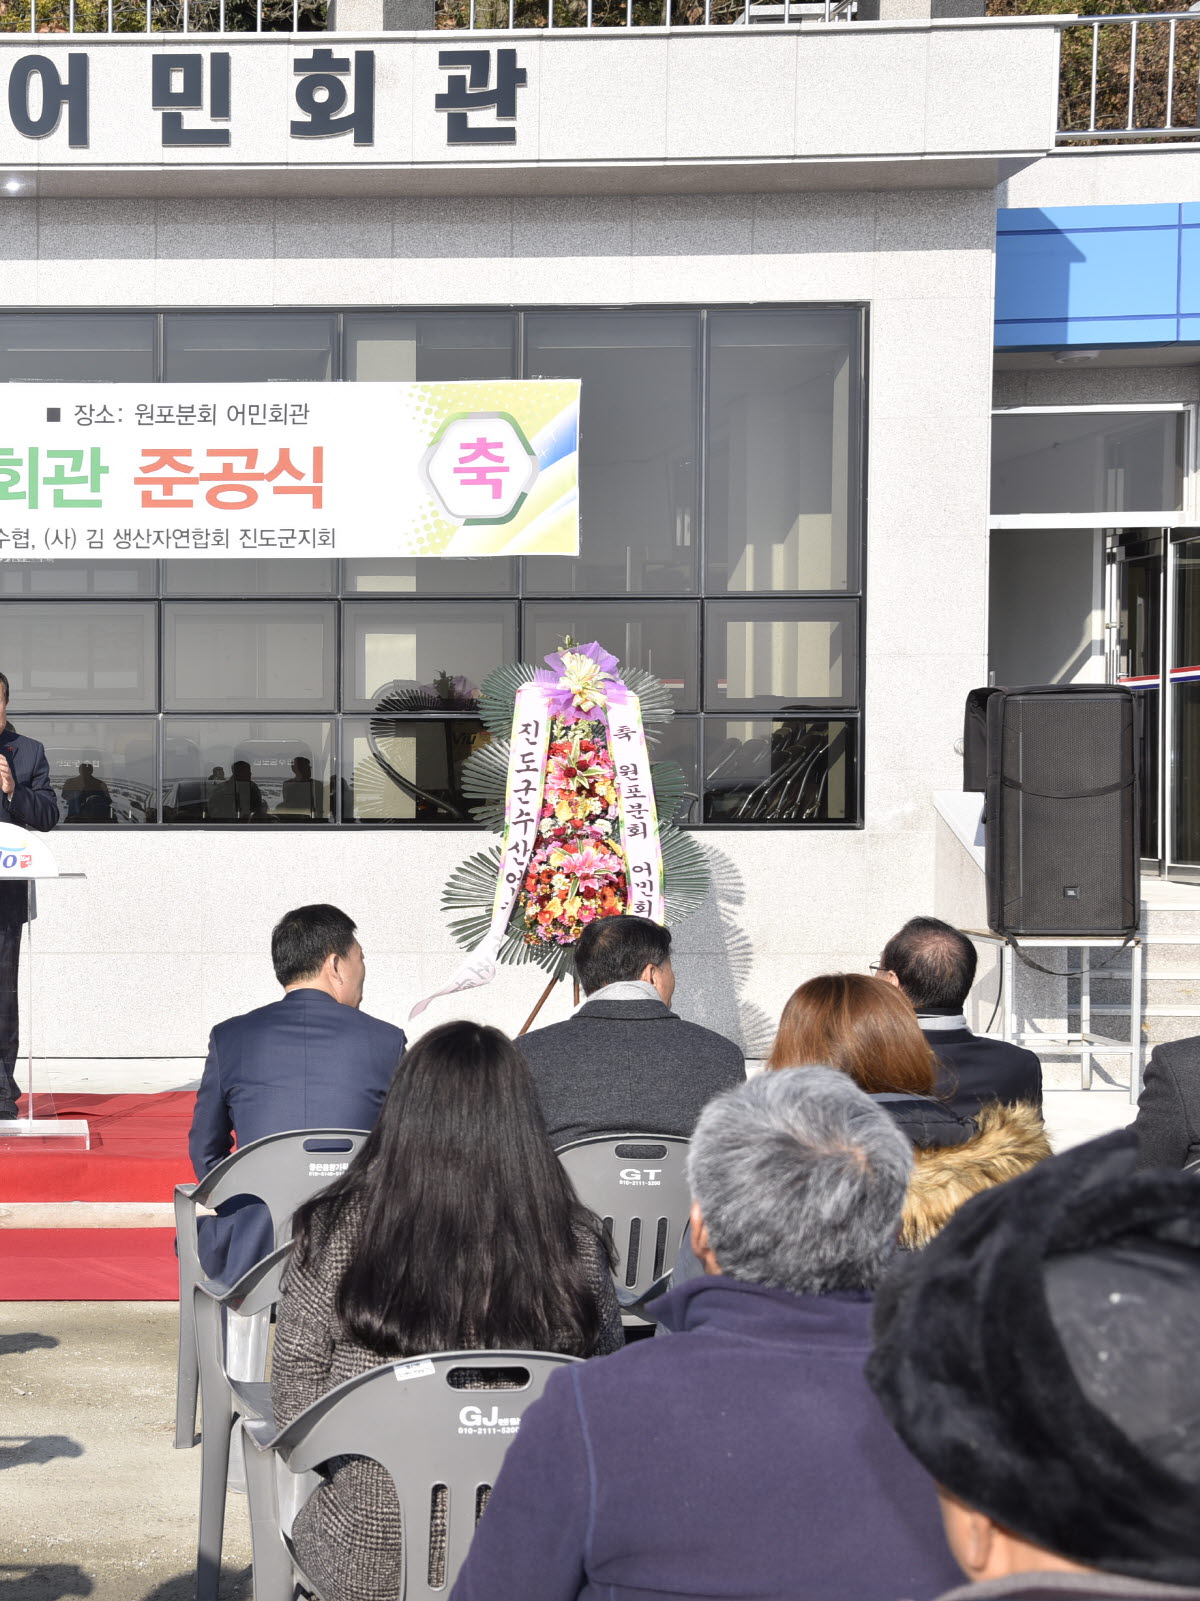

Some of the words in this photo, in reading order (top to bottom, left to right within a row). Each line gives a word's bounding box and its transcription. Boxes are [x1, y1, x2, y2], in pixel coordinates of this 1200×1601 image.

[73, 402, 123, 426] 장소:
[134, 402, 217, 427] 원포분회
[226, 402, 311, 427] 어민회관
[133, 444, 325, 511] 준공식
[453, 436, 511, 500] 축
[44, 527, 77, 551] (사)
[86, 527, 105, 550] 김
[112, 527, 229, 551] 생산자연합회
[239, 527, 336, 551] 진도군지회
[613, 725, 637, 742] 축
[619, 762, 649, 839] 원포분회
[619, 1168, 662, 1181] GT
